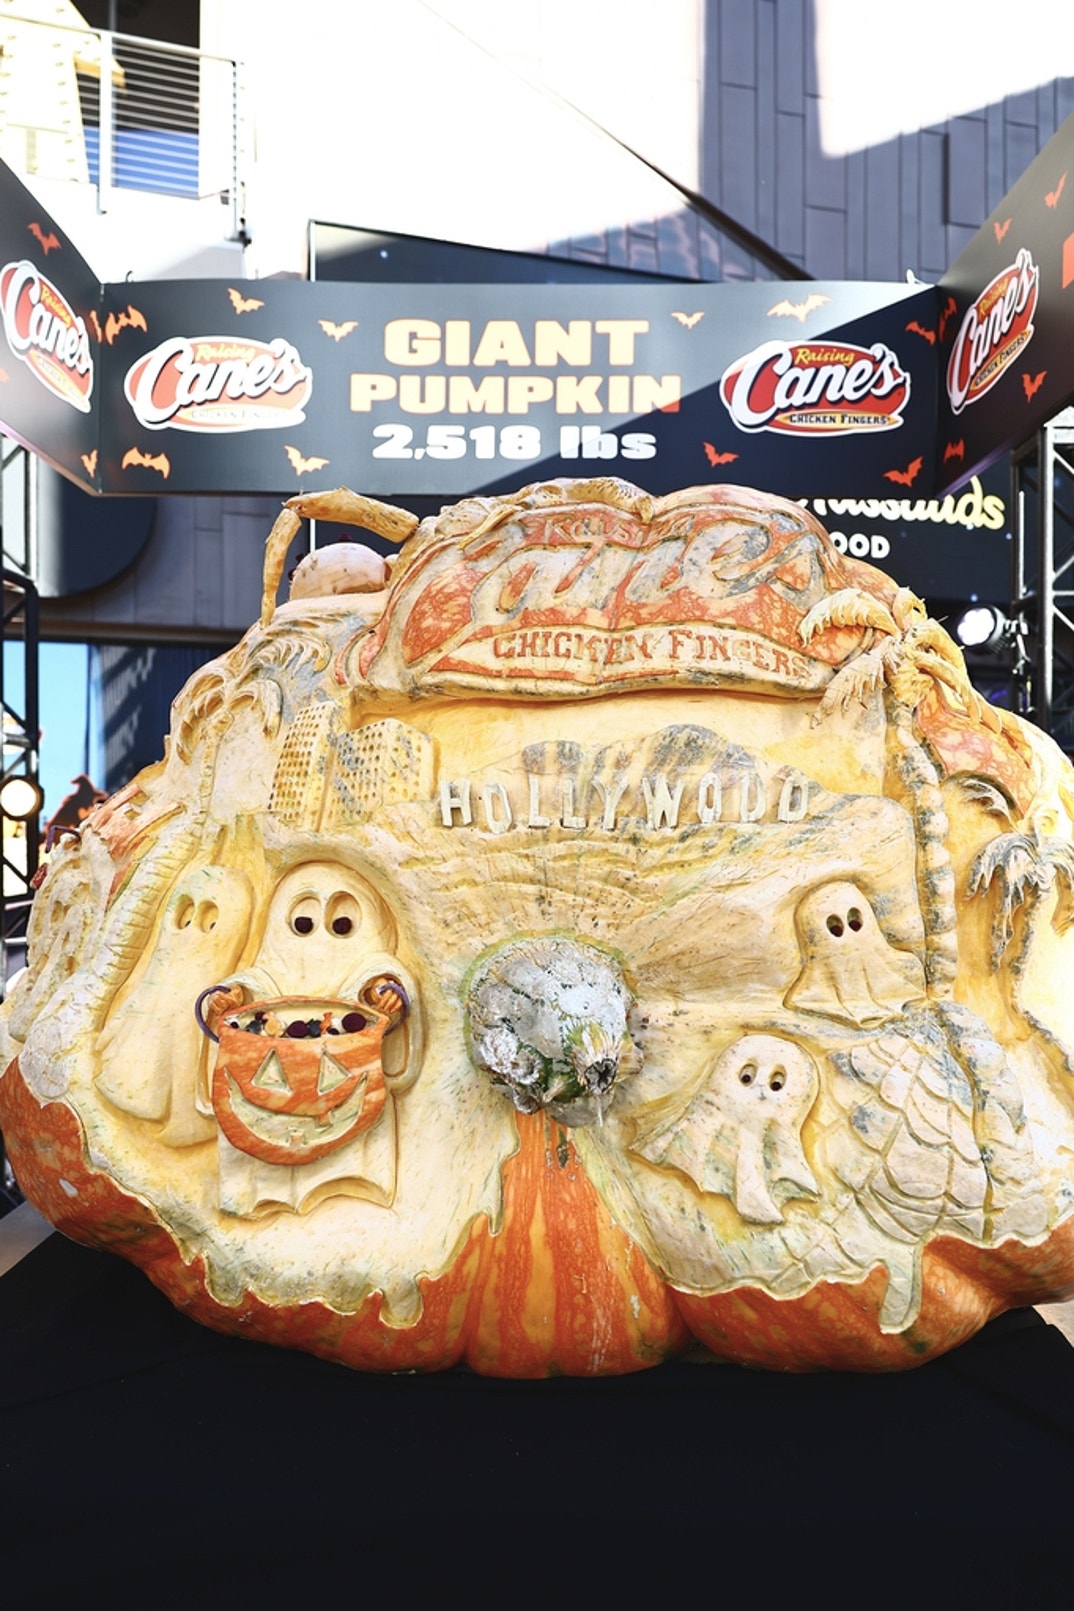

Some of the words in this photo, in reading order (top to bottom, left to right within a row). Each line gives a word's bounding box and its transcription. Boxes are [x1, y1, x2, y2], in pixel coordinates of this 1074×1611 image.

[384, 318, 649, 366] GIANT
[794, 348, 854, 365] Raising
[350, 373, 682, 414] PUMPKIN
[731, 341, 905, 426] Cane's
[789, 414, 837, 424] CHICKEN
[840, 413, 888, 425] FINGERS
[372, 423, 541, 460] 2,518
[559, 425, 657, 460] lbs
[439, 771, 810, 834] HOLLYWOOD
